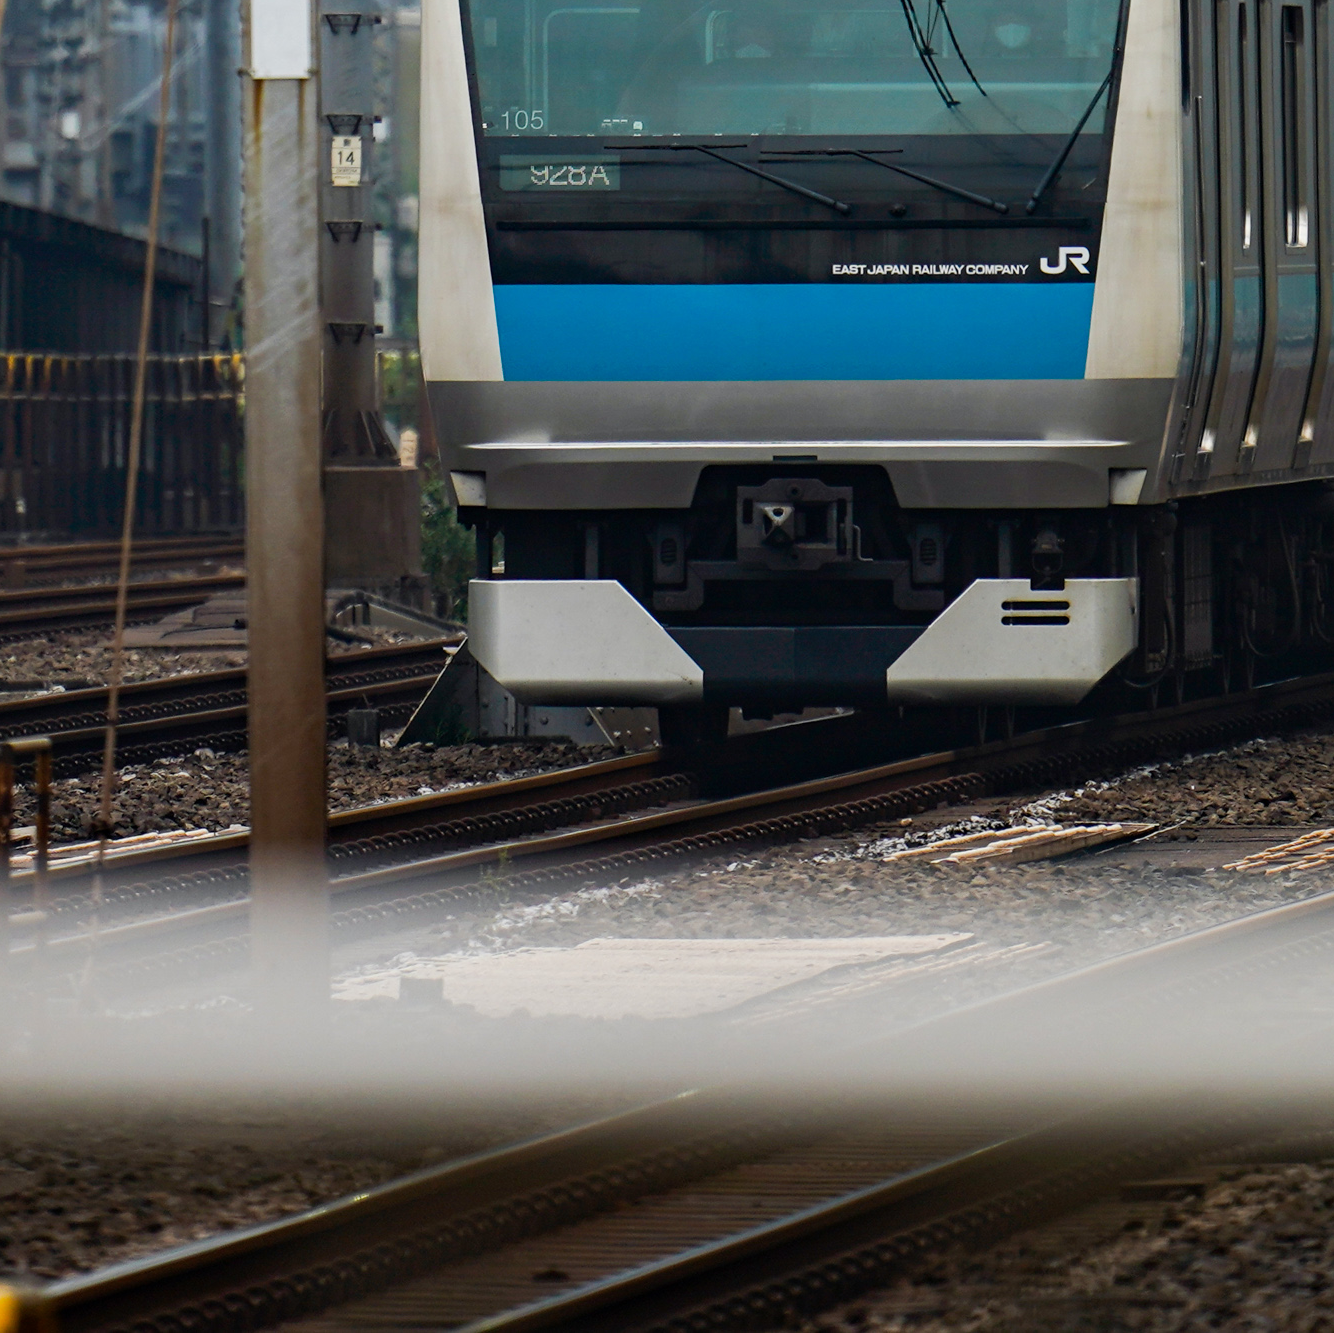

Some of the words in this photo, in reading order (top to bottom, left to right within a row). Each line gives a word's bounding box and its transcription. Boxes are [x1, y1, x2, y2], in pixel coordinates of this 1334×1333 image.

[501, 110, 544, 130] 105
[337, 151, 355, 166] 14
[530, 165, 610, 186] 928A
[832, 264, 867, 275] EAST
[867, 264, 910, 275] JAPAN
[912, 264, 964, 275] RAILWAY
[966, 264, 1029, 275] COMPANY
[1040, 246, 1090, 275] JR
